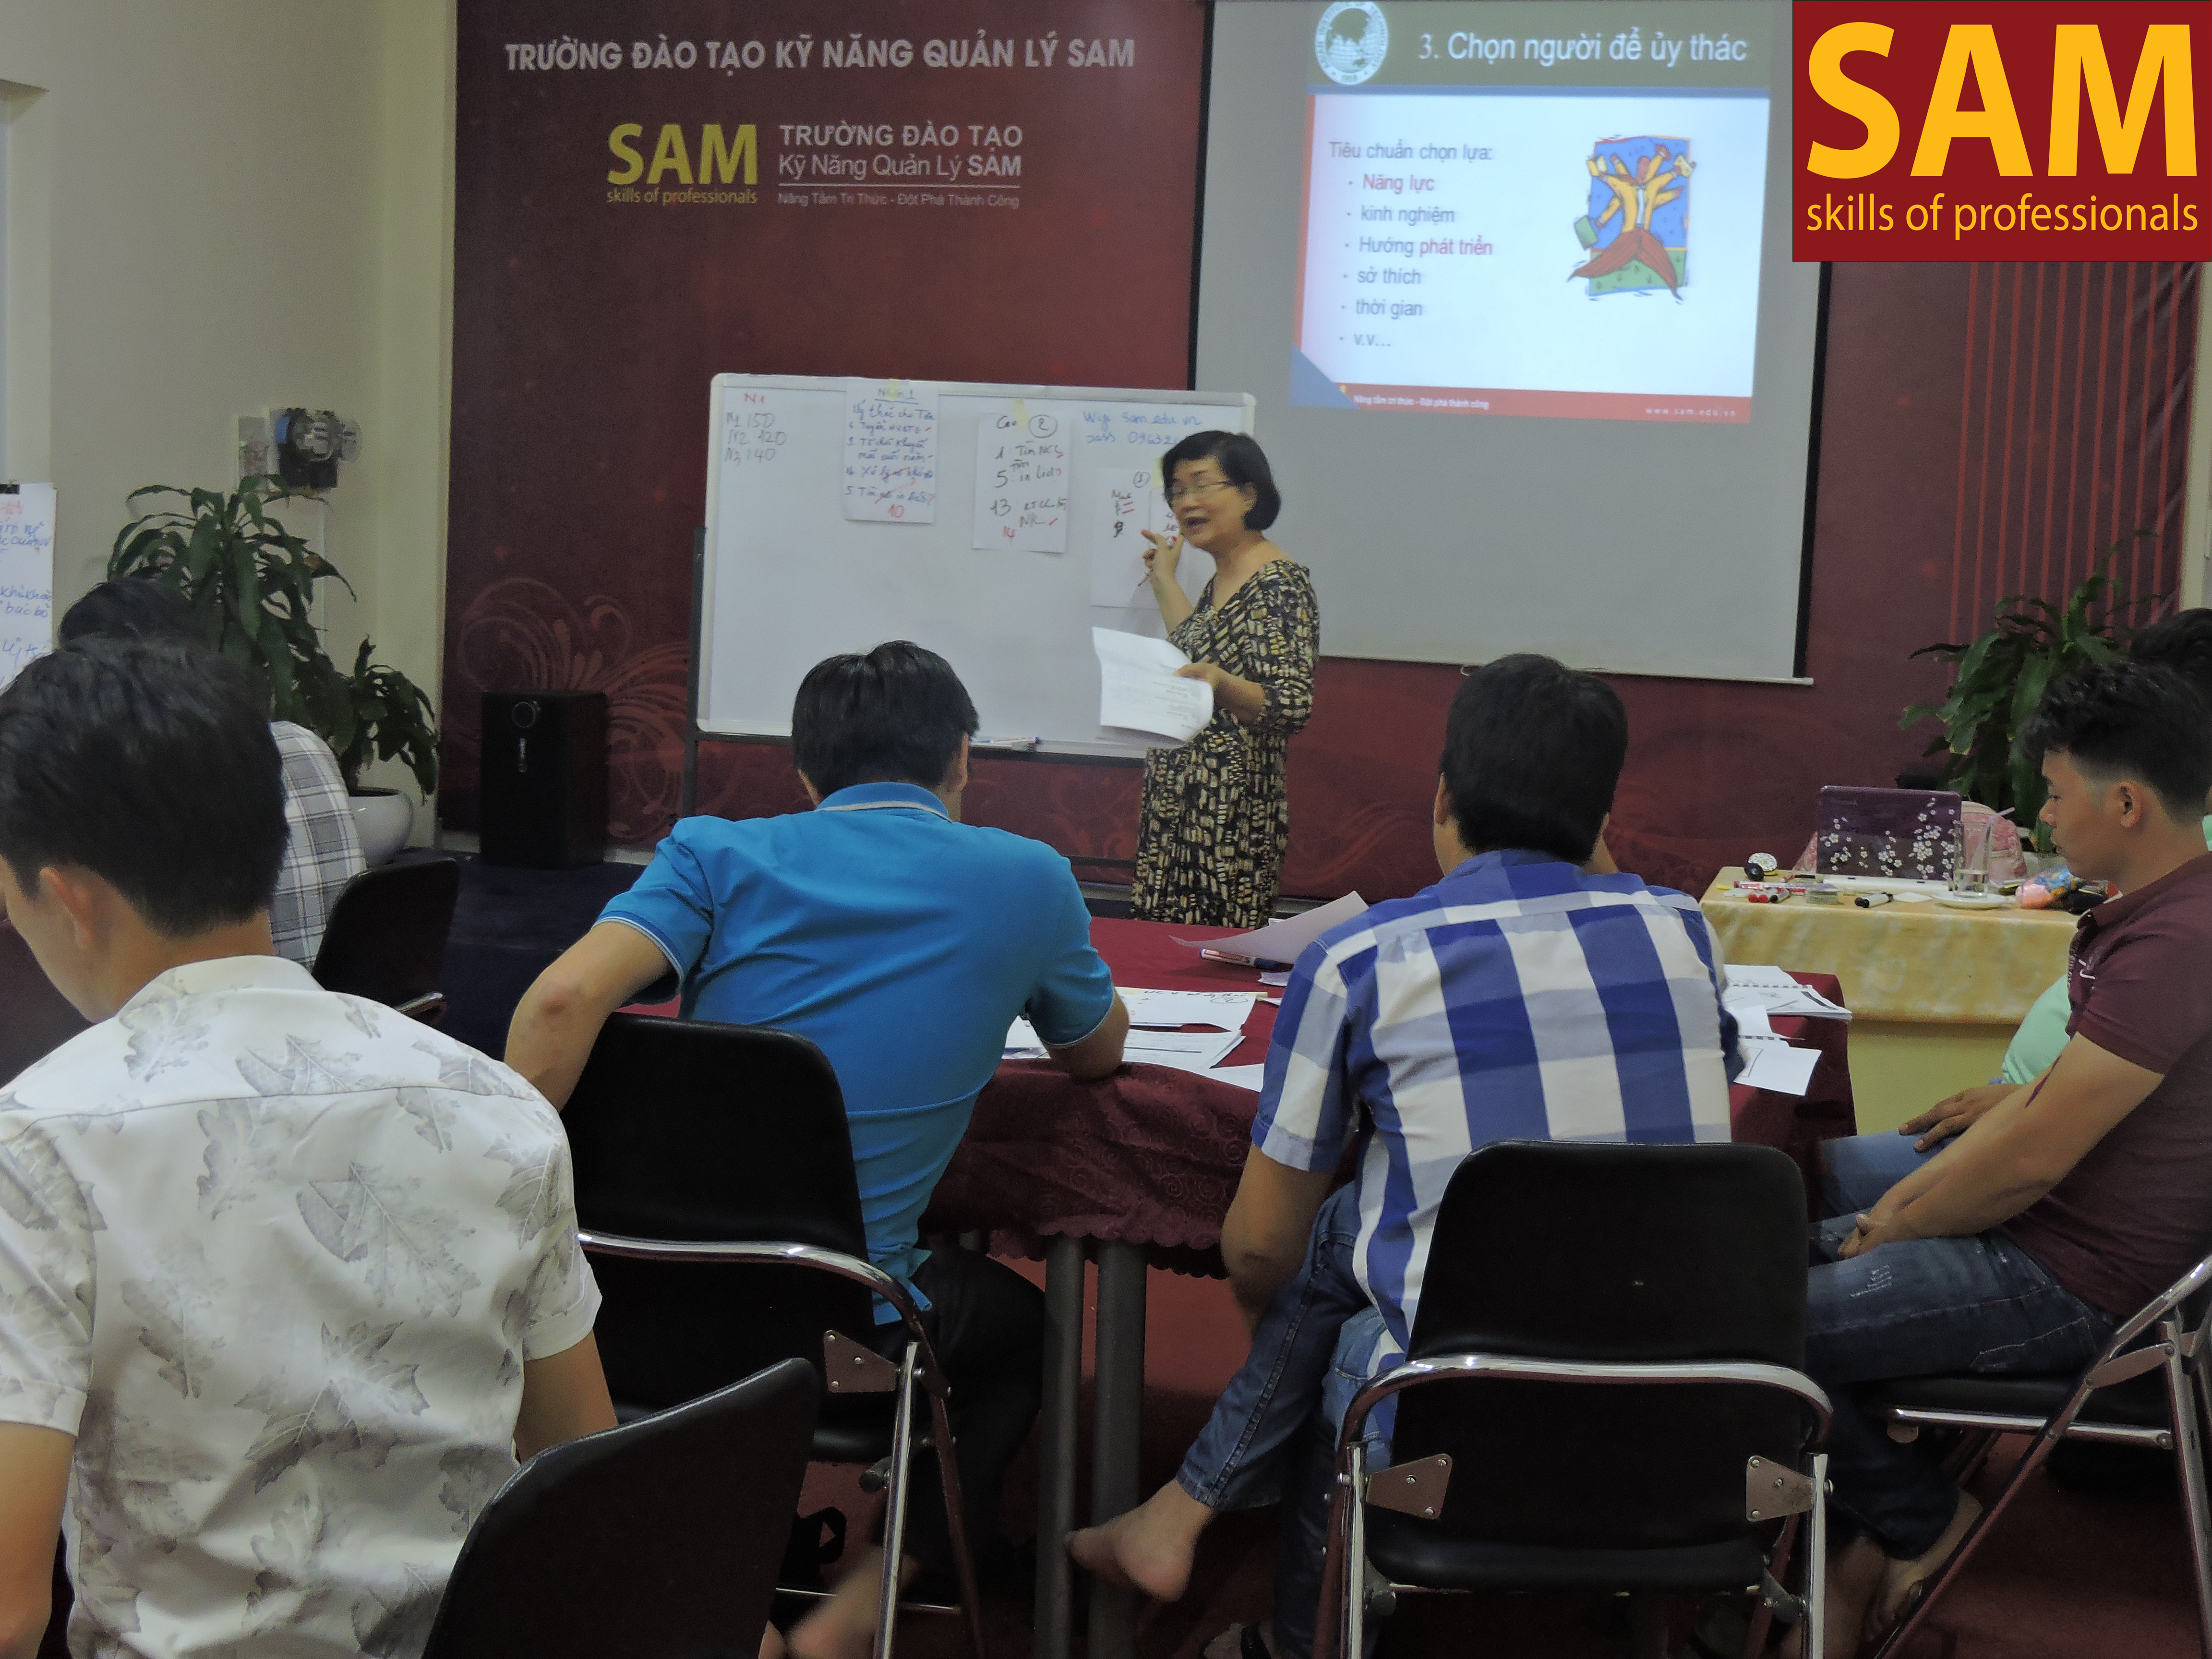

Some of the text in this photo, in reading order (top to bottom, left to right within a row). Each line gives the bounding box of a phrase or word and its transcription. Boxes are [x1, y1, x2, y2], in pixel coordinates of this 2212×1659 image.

[505, 29, 1135, 76] TRƯỜNG ĐÀO TẠO KỸ NĂNG QUẢN LÝ SAM
[1419, 34, 1439, 60] 3.
[1447, 32, 1515, 65] Chọn
[1524, 33, 1601, 67] người
[1609, 26, 1642, 60] để
[1650, 31, 1683, 68] ủy
[1690, 33, 1748, 61] thác
[780, 120, 1023, 151] TRƯỜNG ĐÀO TẠO
[607, 123, 758, 185] SAM
[1329, 141, 1361, 158] Tiêu
[1366, 138, 1413, 158] chuẩn
[1419, 144, 1457, 162] chọn
[779, 153, 1022, 181] Kỹ Năng Quản Lý SAM
[1362, 174, 1435, 194] Năng lực
[607, 187, 758, 206] skills of professionals
[1360, 205, 1455, 226] kinh nghiệm
[1358, 235, 1493, 257] Hướng phát triển
[1357, 266, 1421, 284] sở thích
[1355, 299, 1423, 320] thời gian
